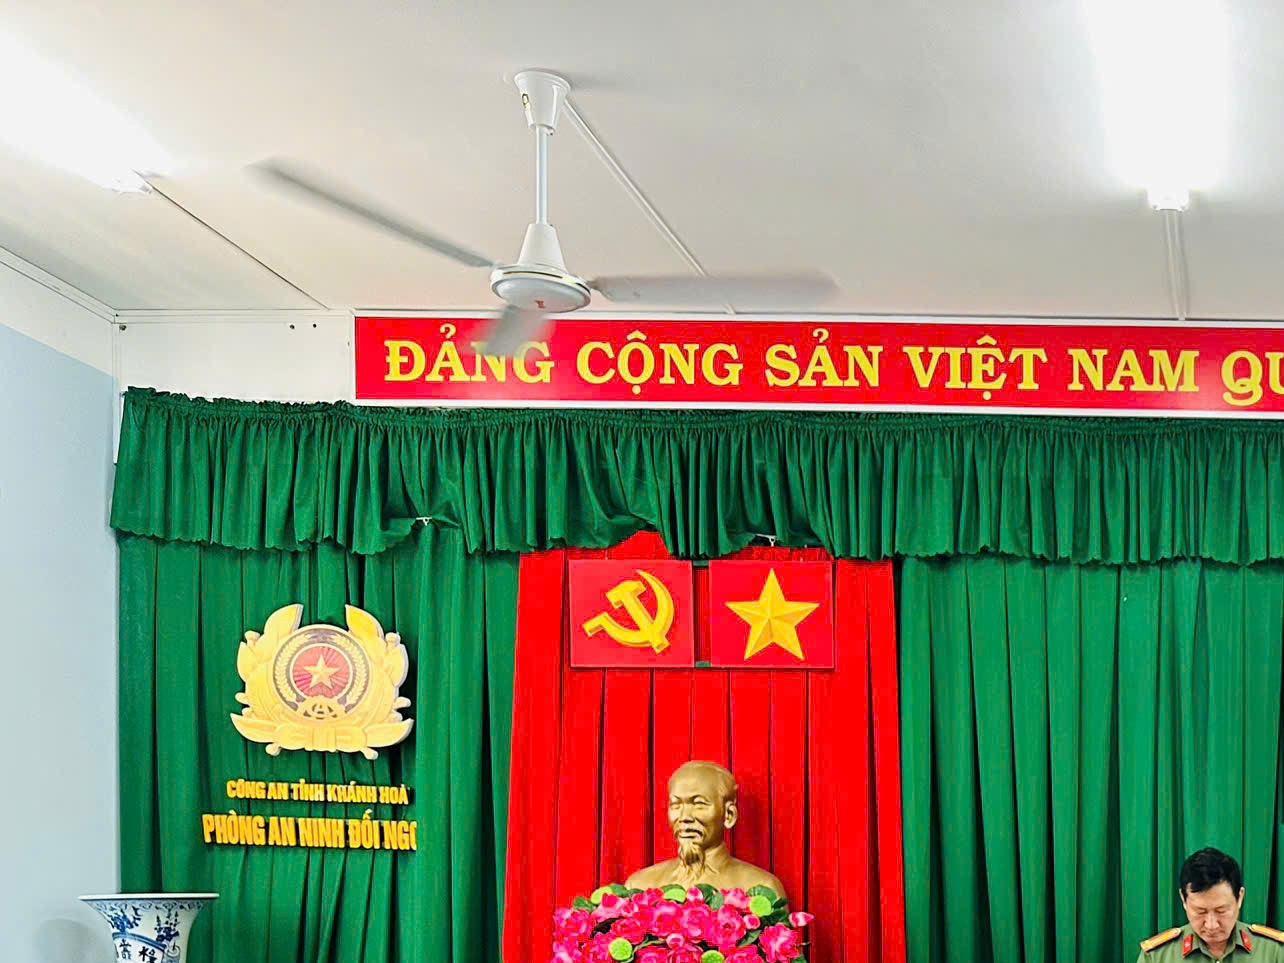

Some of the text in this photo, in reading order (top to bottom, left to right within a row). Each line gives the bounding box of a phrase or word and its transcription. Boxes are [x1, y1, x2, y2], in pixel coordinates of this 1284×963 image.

[384, 323, 554, 384] ĐẢNG
[576, 330, 743, 395] CỘNG
[765, 327, 883, 388] SẢN
[902, 334, 1046, 400] VIỆT
[1067, 347, 1198, 394] NAM
[226, 778, 266, 799] CÔNG
[267, 782, 289, 800] AN
[290, 778, 325, 802] TỈNH
[326, 780, 378, 803] KHÁNH
[202, 809, 266, 846] PHÒNG
[268, 816, 297, 847] AN
[298, 817, 346, 849] NINH
[347, 808, 381, 850] ĐỐI
